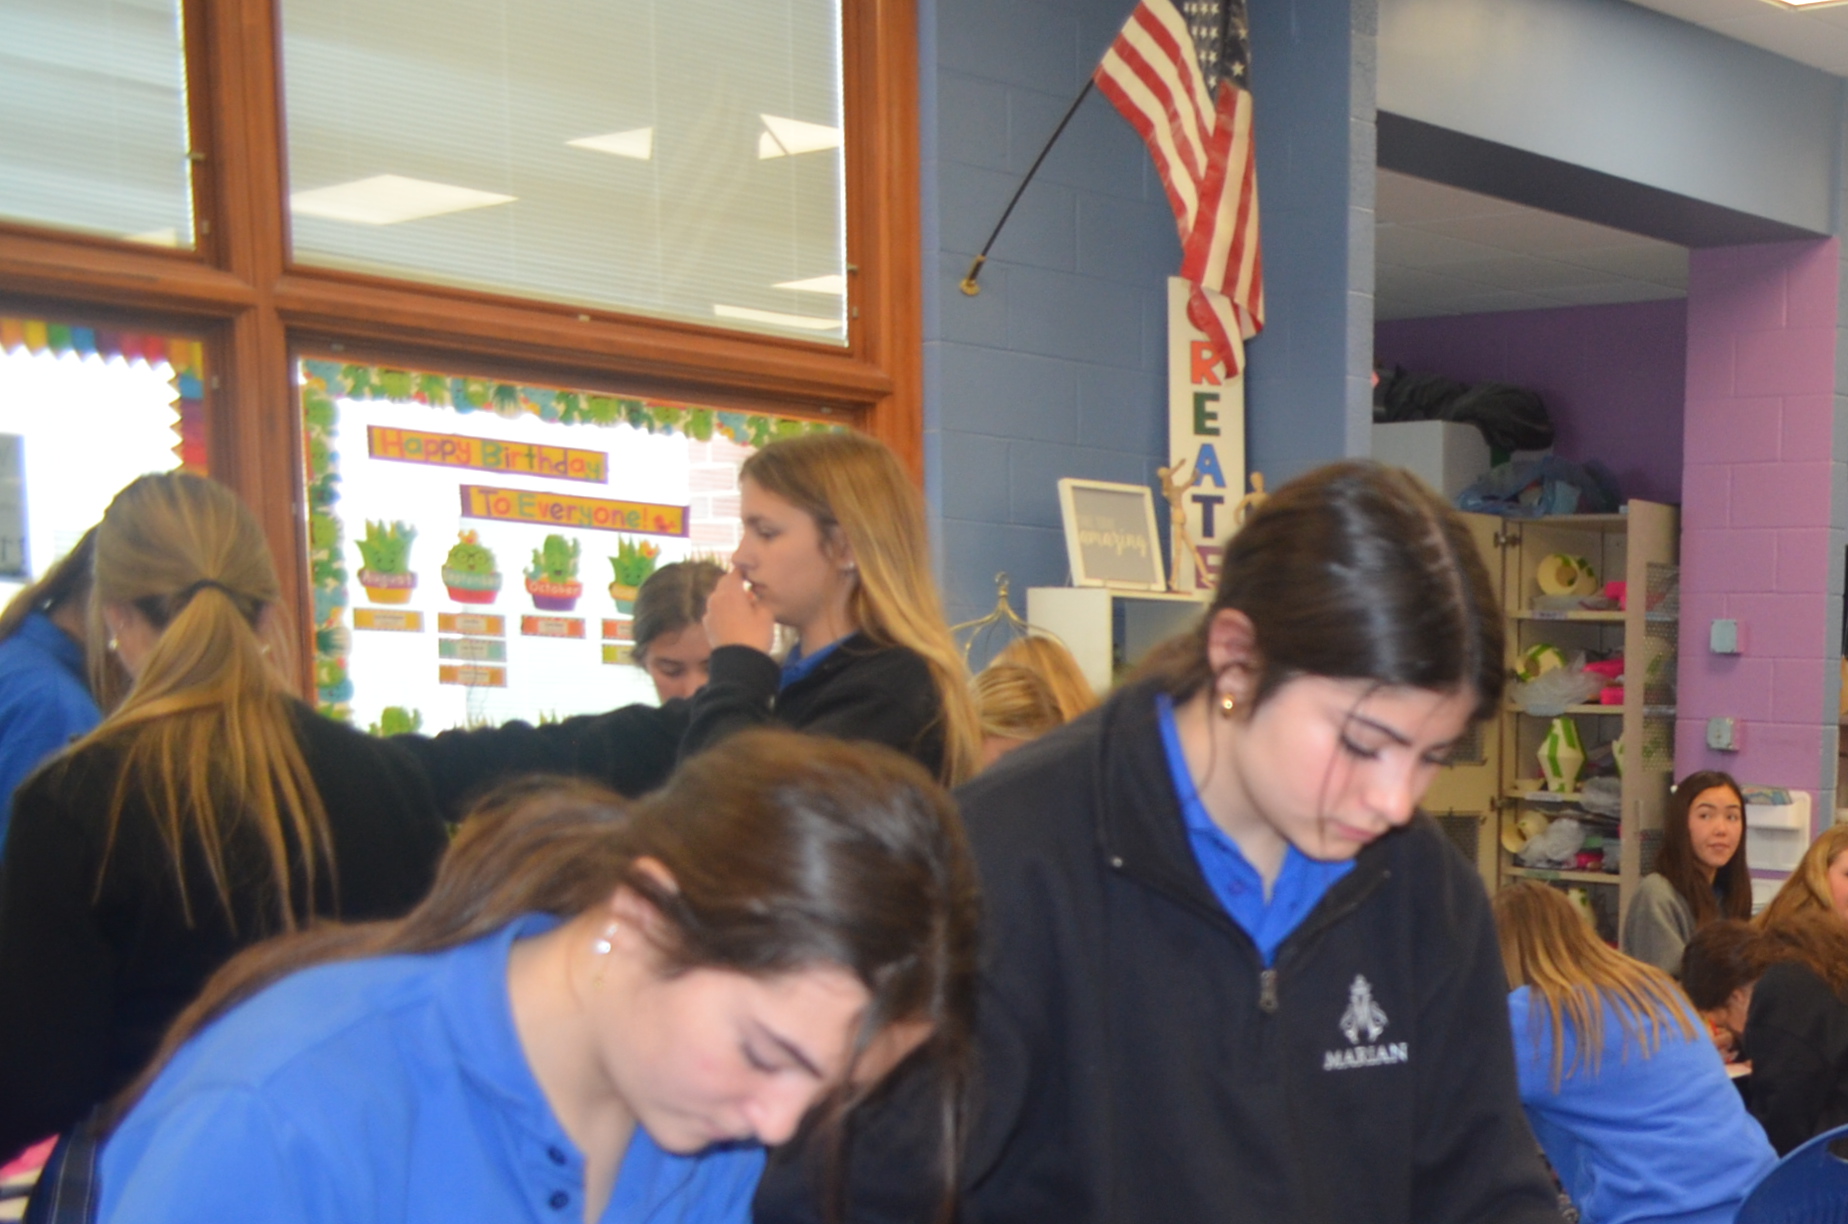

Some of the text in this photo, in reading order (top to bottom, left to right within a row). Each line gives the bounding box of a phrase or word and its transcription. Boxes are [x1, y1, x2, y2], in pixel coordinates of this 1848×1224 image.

[380, 427, 602, 483] Happy Birthday
[477, 488, 650, 530] To Everyone!
[529, 581, 580, 596] October
[1323, 1041, 1410, 1072] MARIAN
